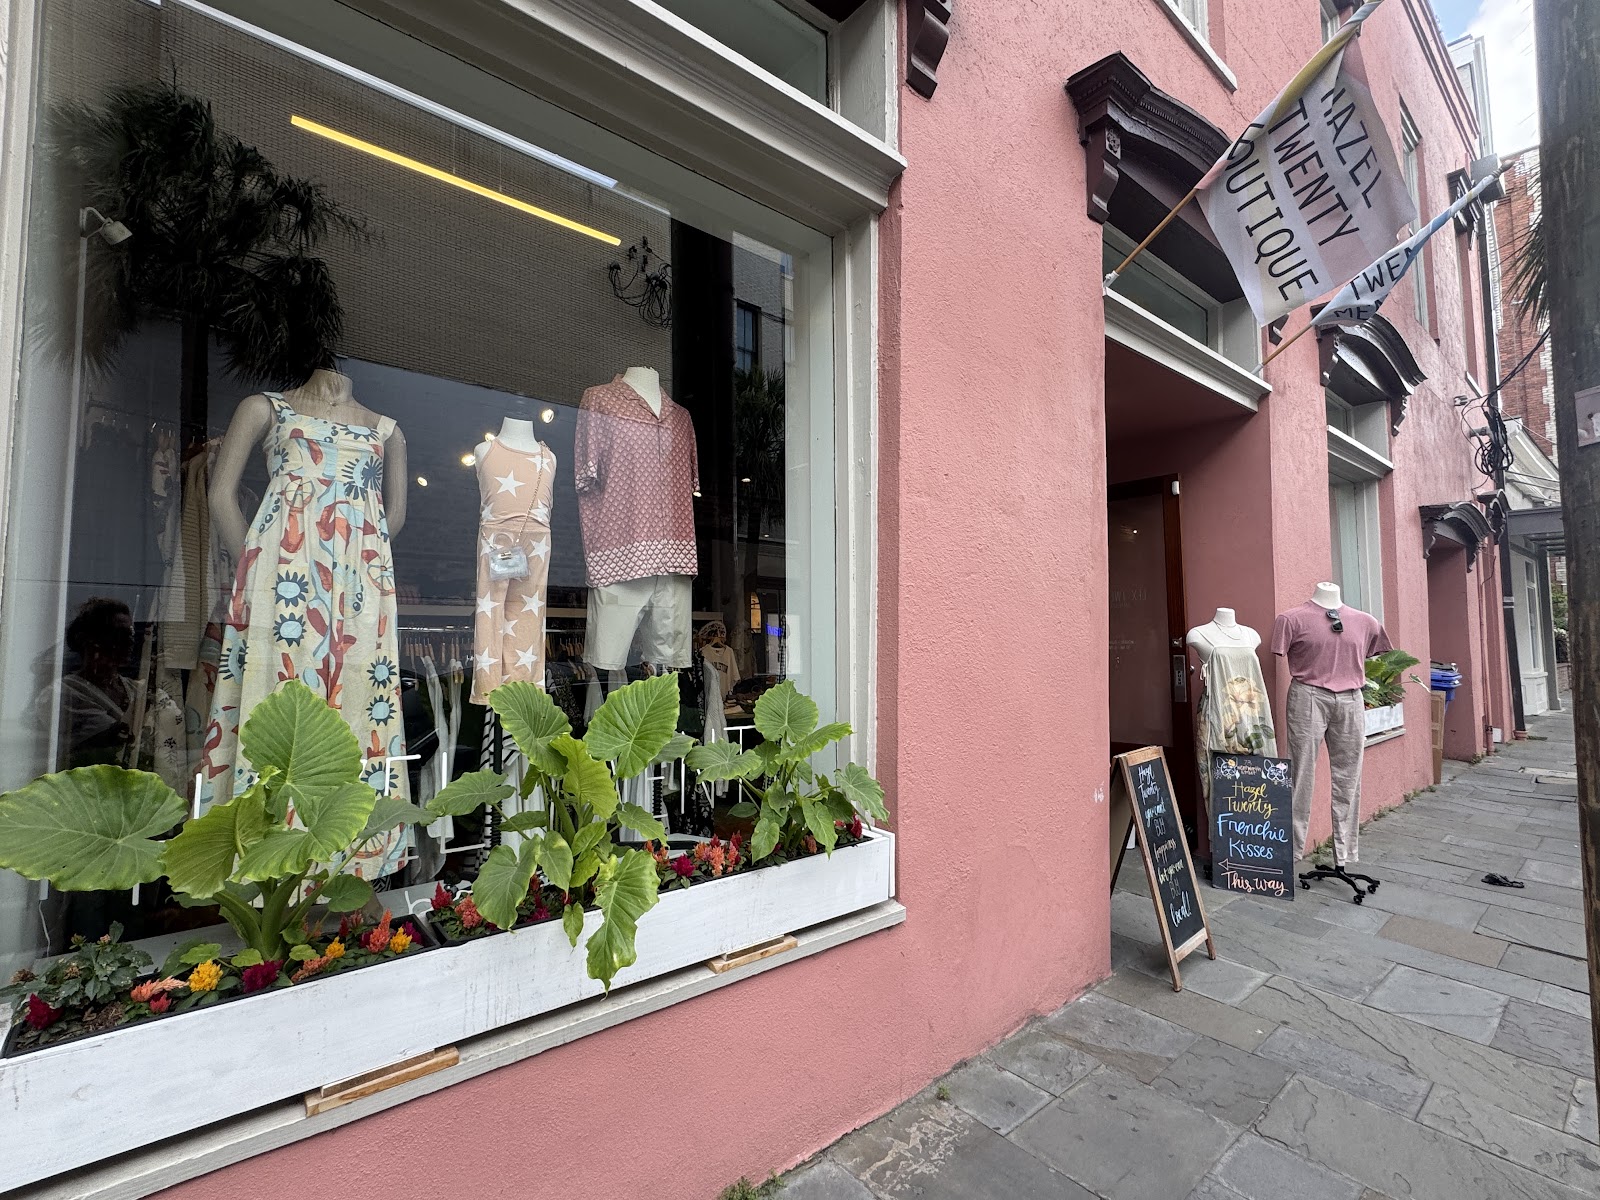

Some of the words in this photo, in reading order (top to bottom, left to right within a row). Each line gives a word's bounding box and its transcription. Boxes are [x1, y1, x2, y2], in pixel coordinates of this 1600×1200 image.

[1268, 98, 1360, 247] TWENTY
[1231, 781, 1268, 802] Hazel
[1222, 796, 1279, 820] Twenty
[1217, 812, 1289, 843] Frenchie
[1229, 837, 1274, 860] Kisses
[1221, 870, 1255, 893] This
[1253, 877, 1290, 896] way
